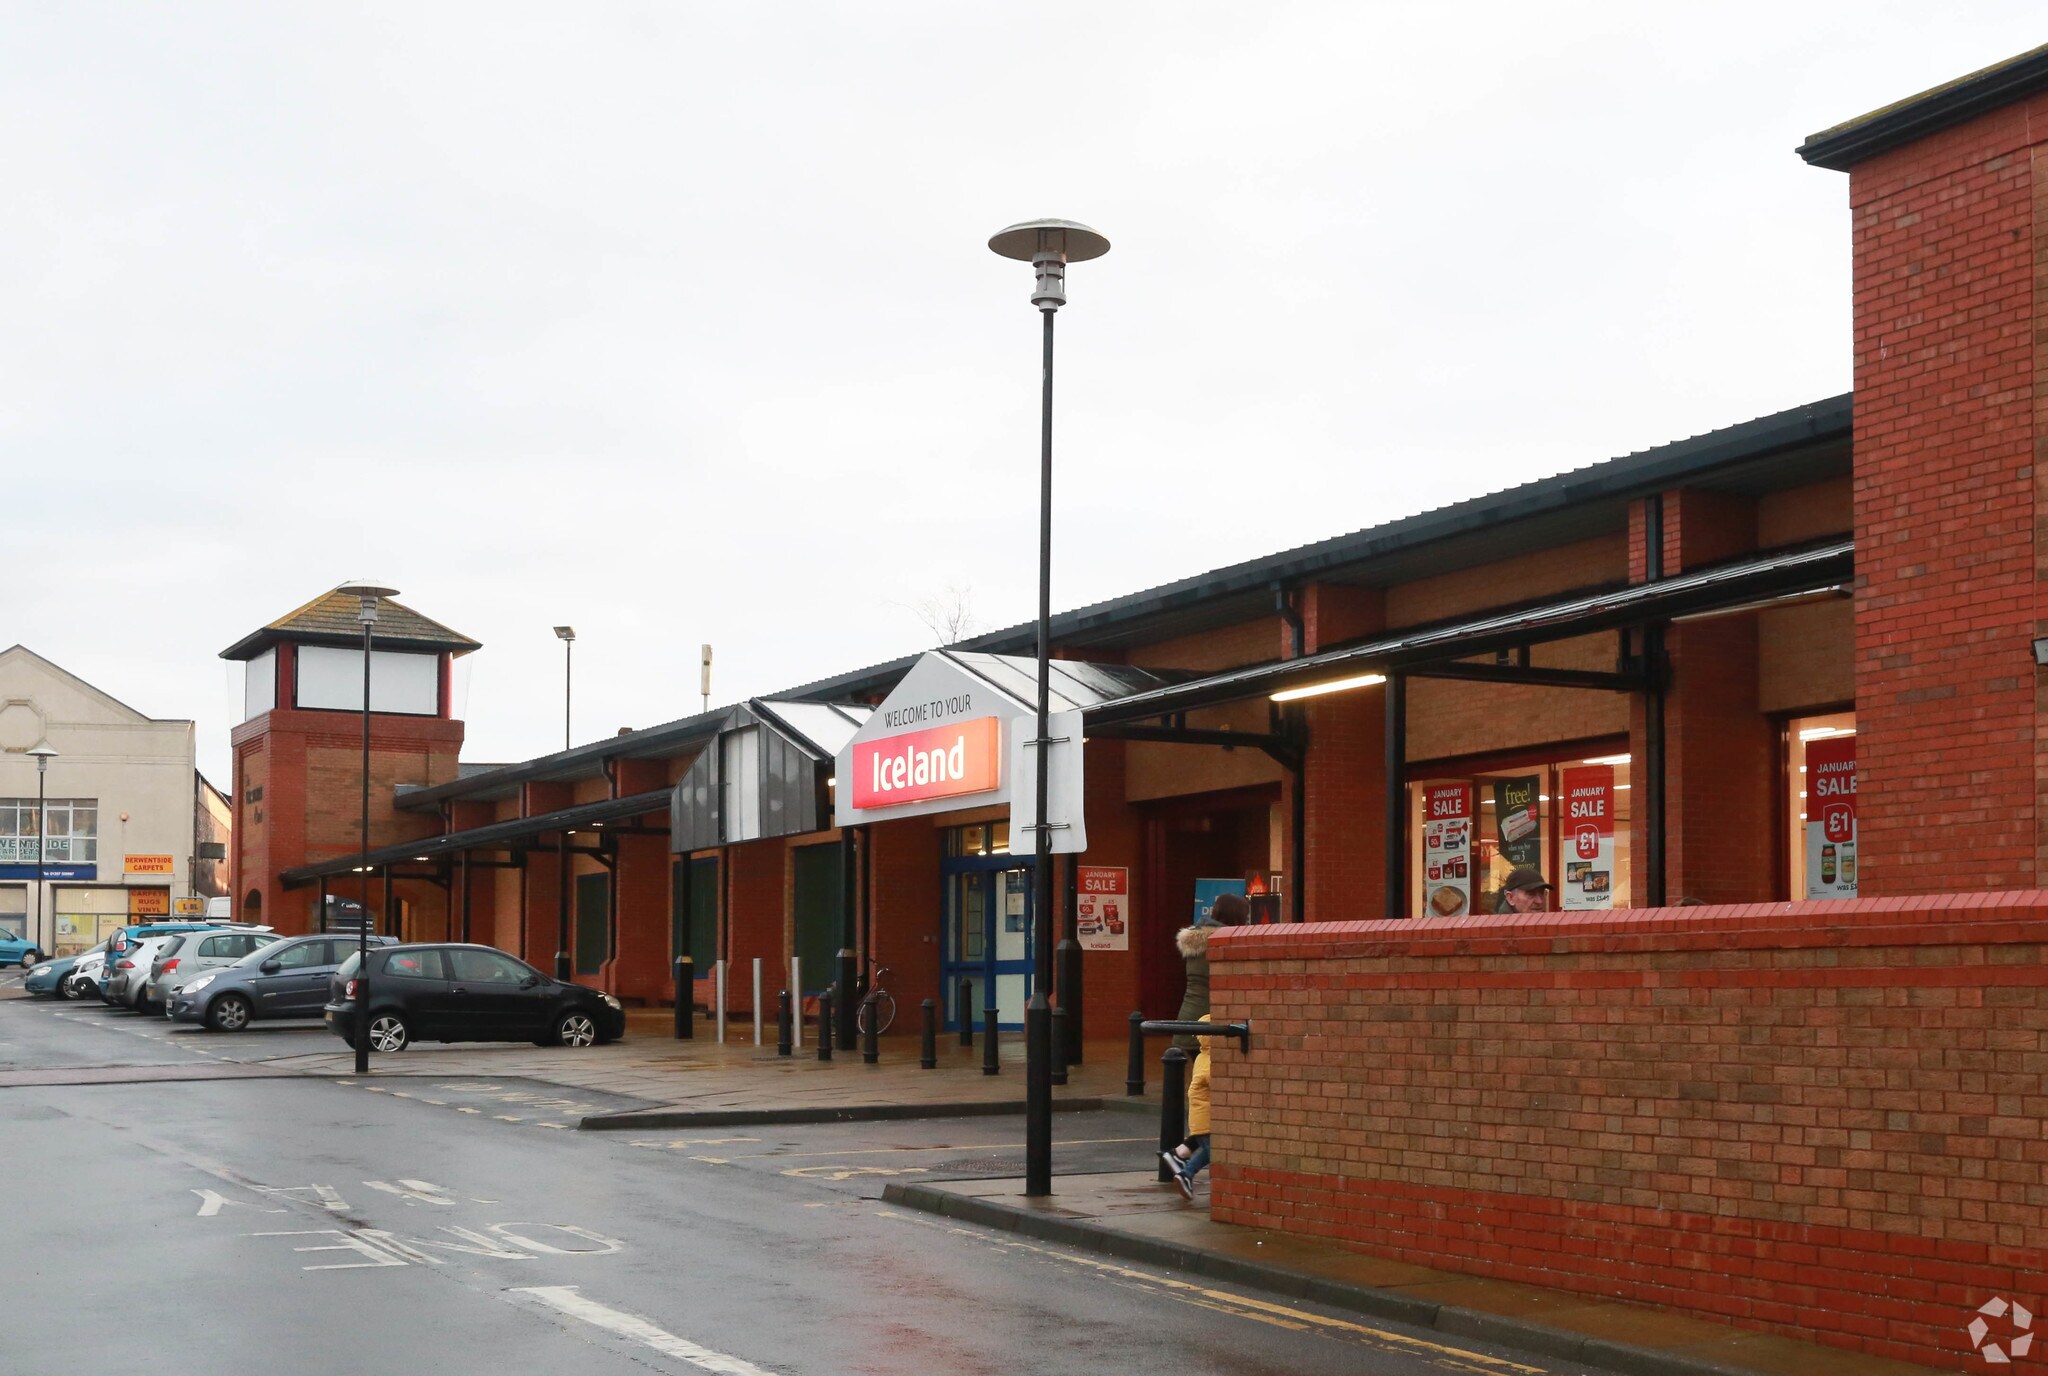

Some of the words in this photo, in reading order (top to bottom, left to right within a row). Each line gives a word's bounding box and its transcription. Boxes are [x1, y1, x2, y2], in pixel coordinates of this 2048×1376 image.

[884, 703, 927, 728] WELCOME
[930, 700, 943, 718] TO
[945, 694, 971, 715] YOUR
[873, 735, 964, 792] Iceland
[1433, 788, 1462, 799] JANUARY
[1506, 783, 1531, 804] free!
[1571, 787, 1605, 798] JANUARY
[1817, 776, 1857, 796] SALE
[1433, 799, 1462, 816] SALE
[1571, 800, 1605, 818] SALE
[1829, 812, 1849, 833] £1
[1580, 832, 1595, 850] £1
[1085, 880, 1116, 891] SALE
